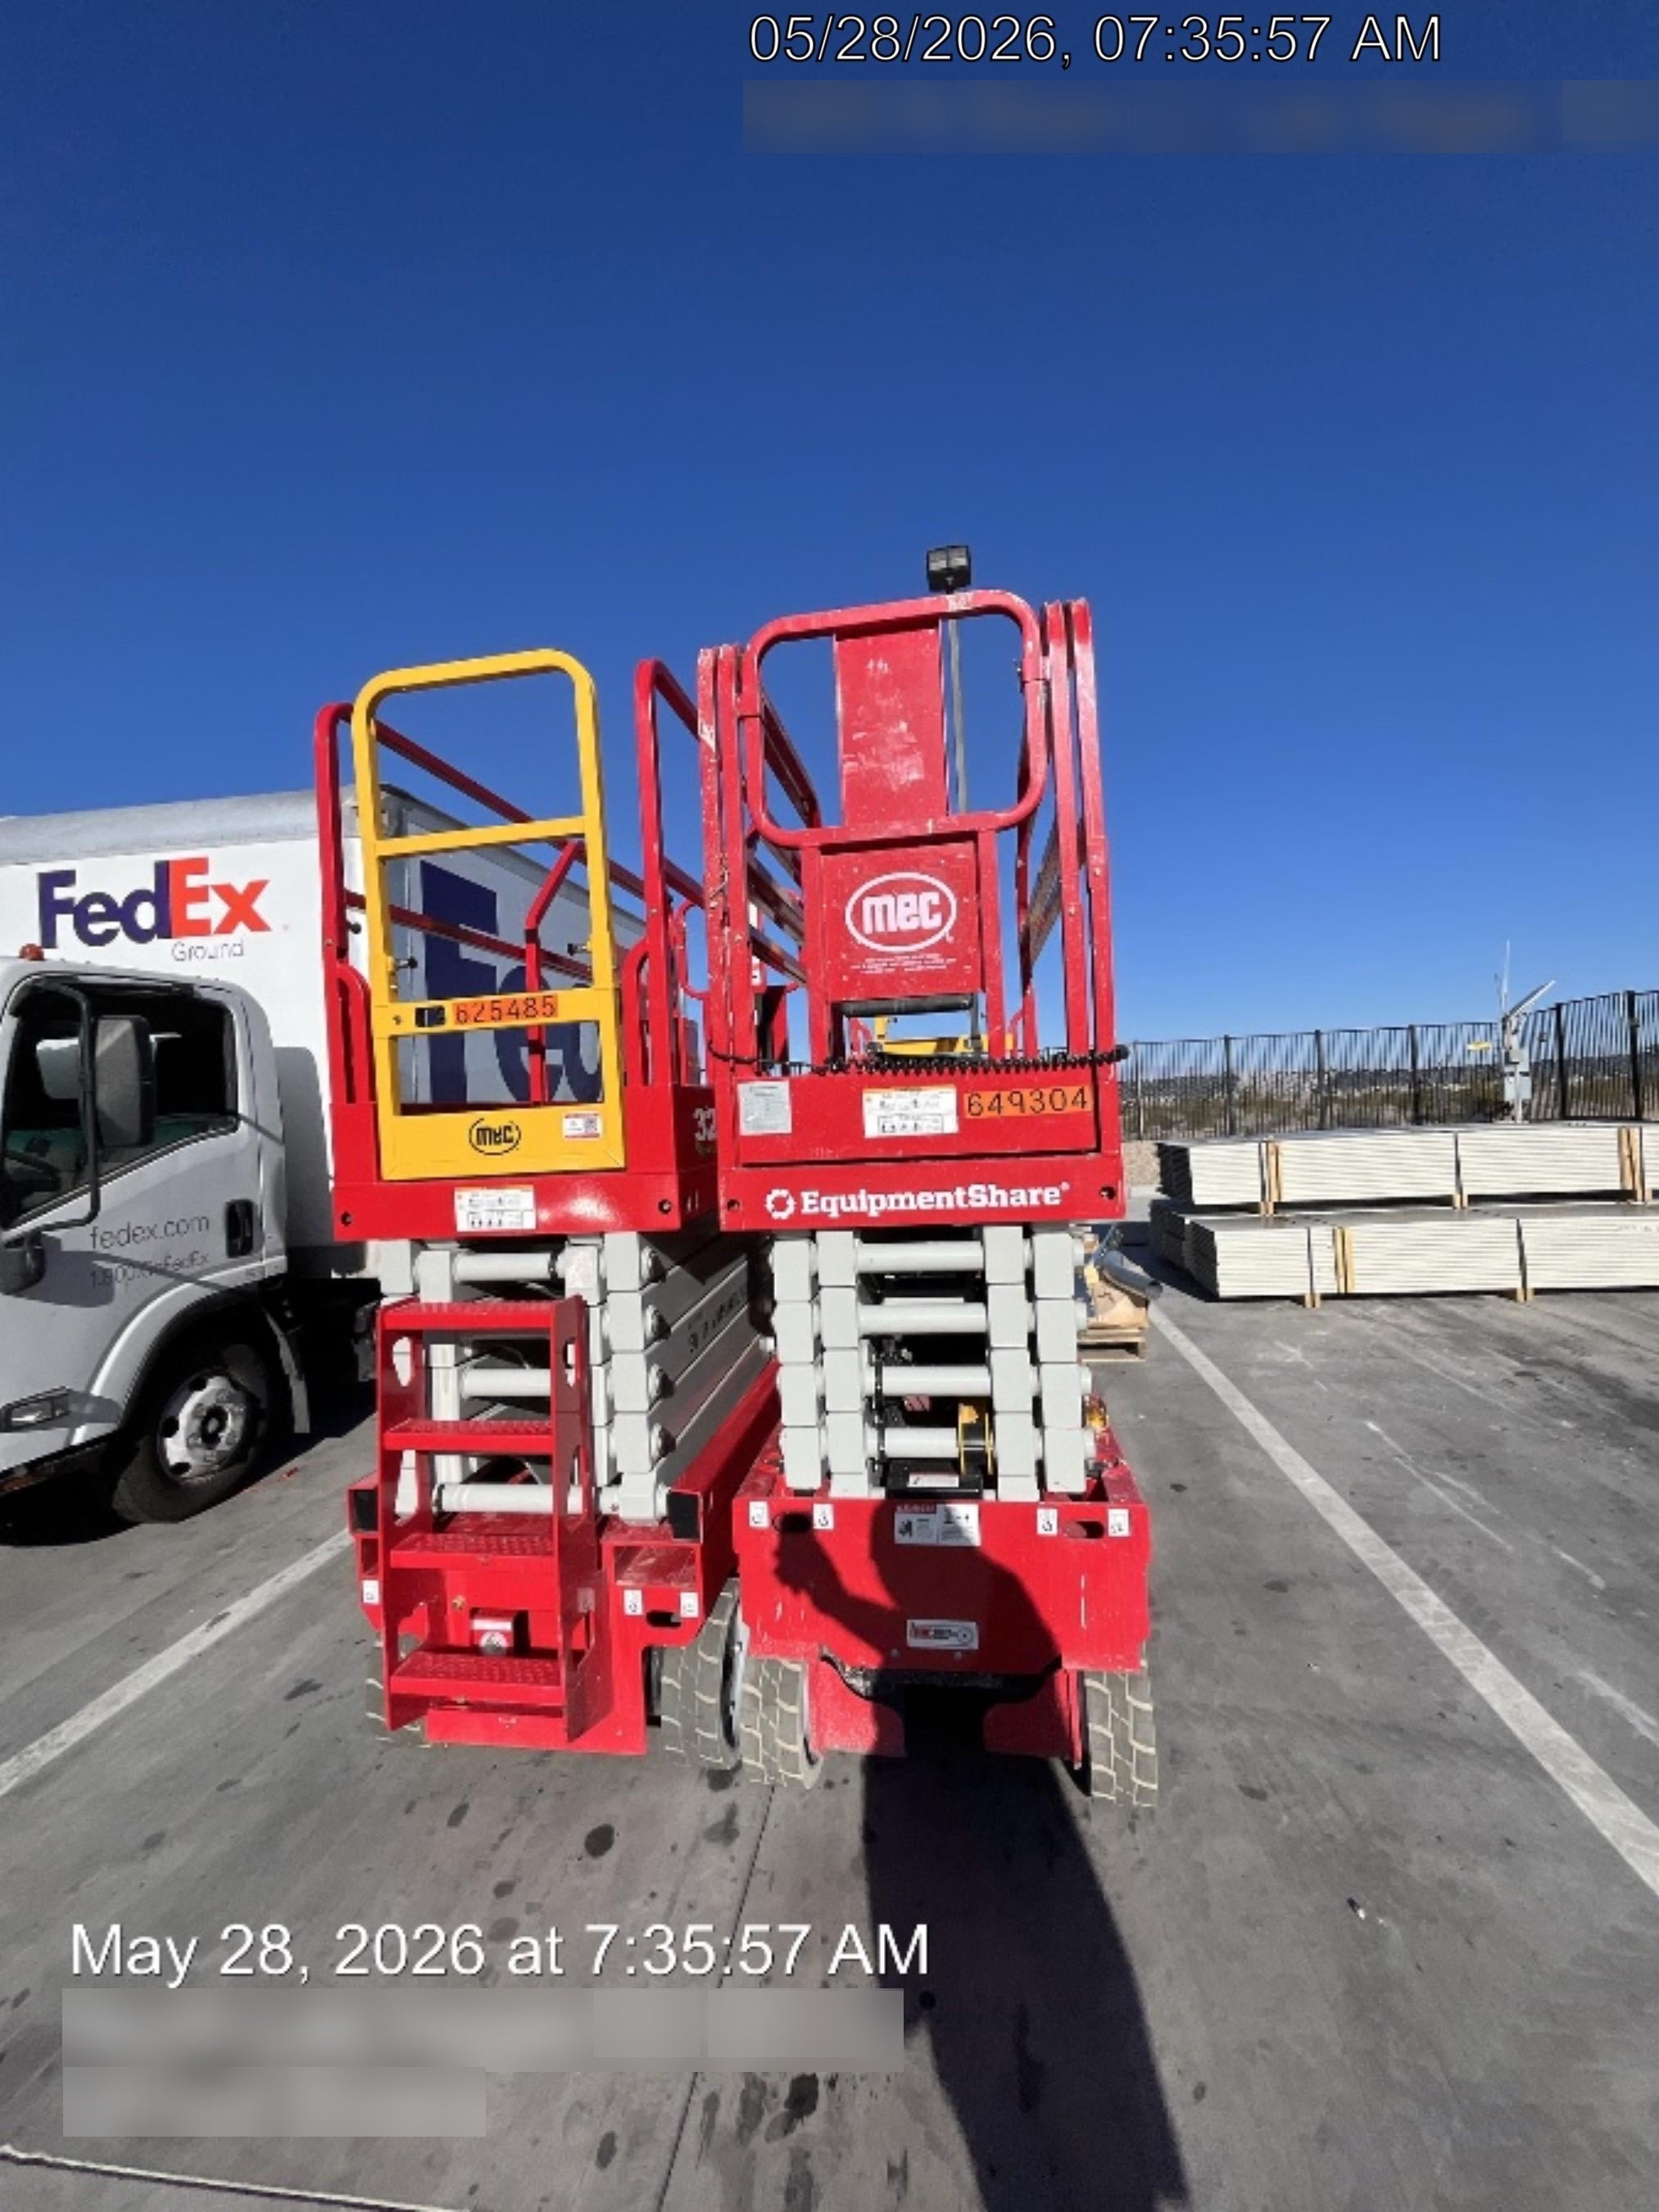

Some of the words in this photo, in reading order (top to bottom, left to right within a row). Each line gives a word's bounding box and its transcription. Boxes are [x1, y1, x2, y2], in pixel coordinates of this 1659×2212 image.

[39, 857, 273, 949] FedEx
[171, 940, 244, 962] Ground
[456, 995, 555, 1025] 625485
[968, 1086, 1087, 1117] 649304
[90, 1216, 210, 1249] fedex.com
